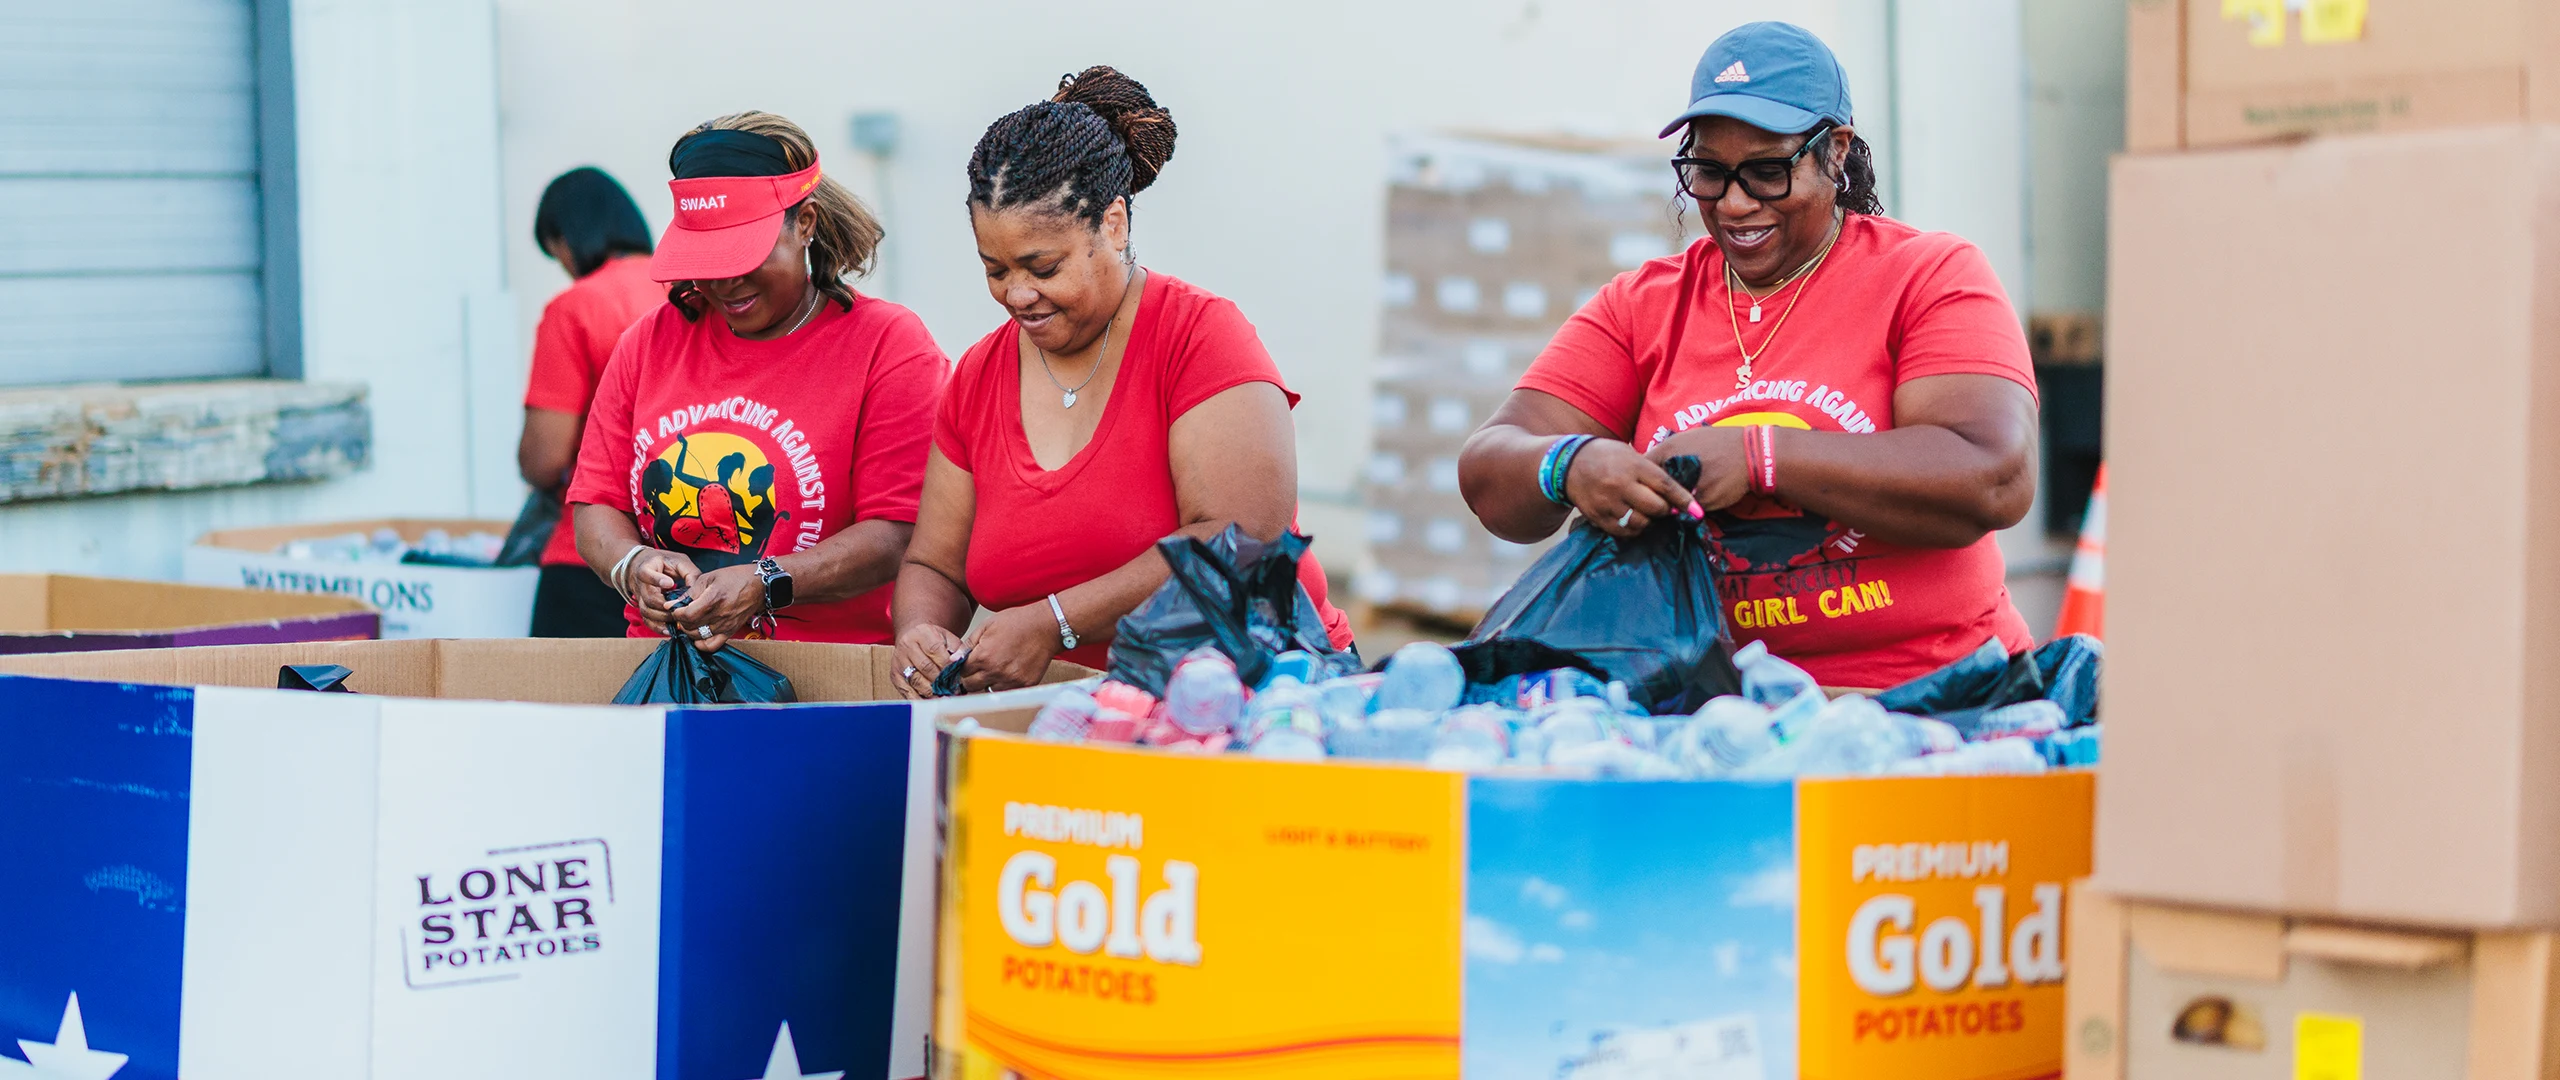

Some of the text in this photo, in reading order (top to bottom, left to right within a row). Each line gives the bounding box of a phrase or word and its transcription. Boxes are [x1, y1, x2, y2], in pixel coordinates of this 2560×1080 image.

[1714, 75, 1750, 83] adidas
[680, 195, 727, 210] SWAAT
[1804, 384, 1876, 434] AGAIN
[630, 396, 825, 553] WOMEN ADVANCING AGAINST TU
[241, 567, 433, 613] WATERMELONS
[1774, 560, 1858, 597] SOCIETY
[1733, 579, 1893, 629] GIRL CAN!
[1004, 801, 1143, 849] PREMIUM
[417, 860, 591, 905] LONE
[1853, 841, 2009, 883] PREMIUM
[421, 898, 595, 945] STAR
[998, 850, 1202, 966] Gold
[425, 933, 600, 970] POTATOES
[1846, 884, 2065, 996] Gold
[1003, 956, 1157, 1005] POTATOES
[1855, 1000, 2024, 1044] POTATOES
